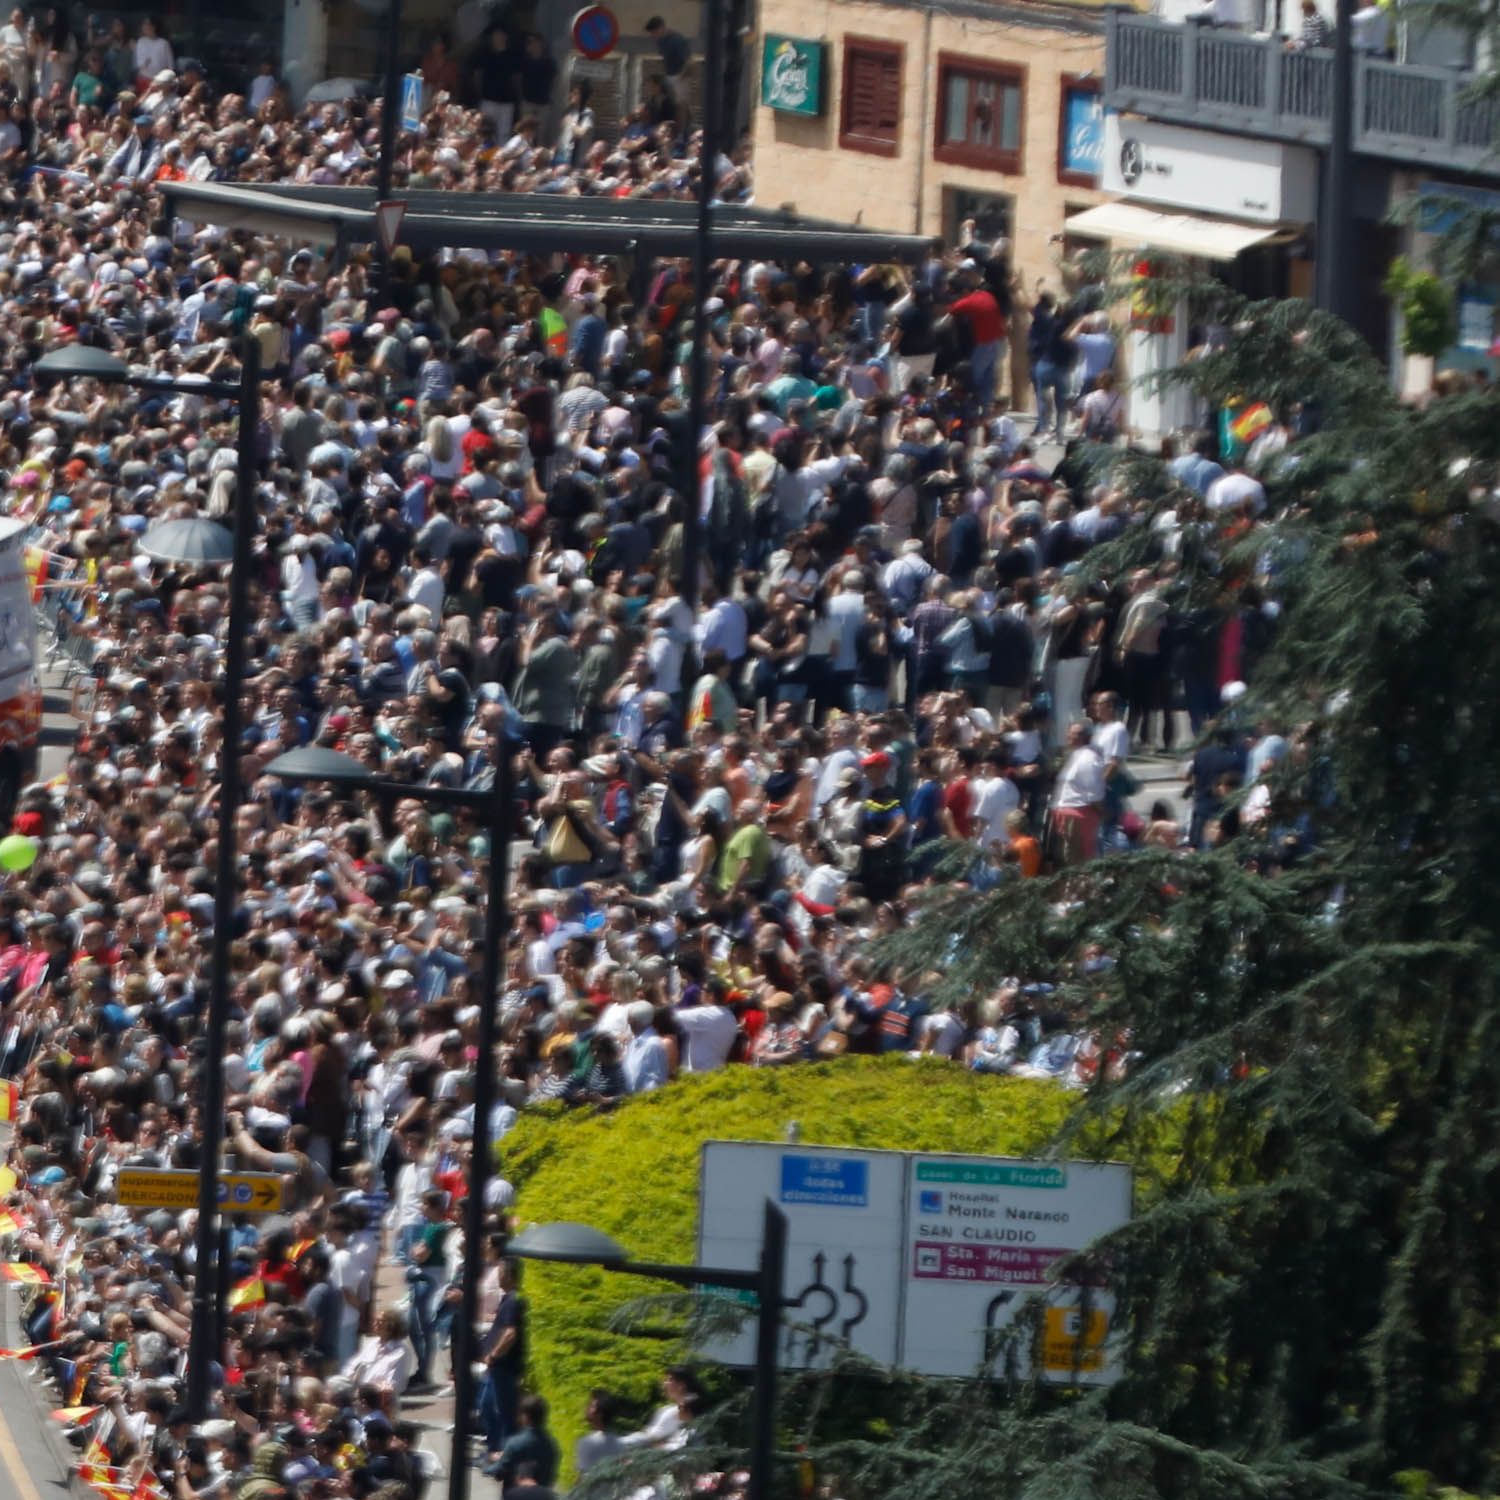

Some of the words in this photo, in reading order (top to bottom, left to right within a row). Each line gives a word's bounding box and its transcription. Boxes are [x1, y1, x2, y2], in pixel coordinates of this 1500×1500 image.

[1011, 1171, 1063, 1186] Florida
[950, 1191, 999, 1203] Hospital
[949, 1205, 996, 1218] Monte
[1006, 1207, 1070, 1223] Naranco
[920, 1224, 952, 1237] SAN
[963, 1227, 1037, 1242] CLAUDIO
[947, 1246, 979, 1260] Sta.
[947, 1266, 976, 1278] San
[985, 1266, 1037, 1281] Miguel
